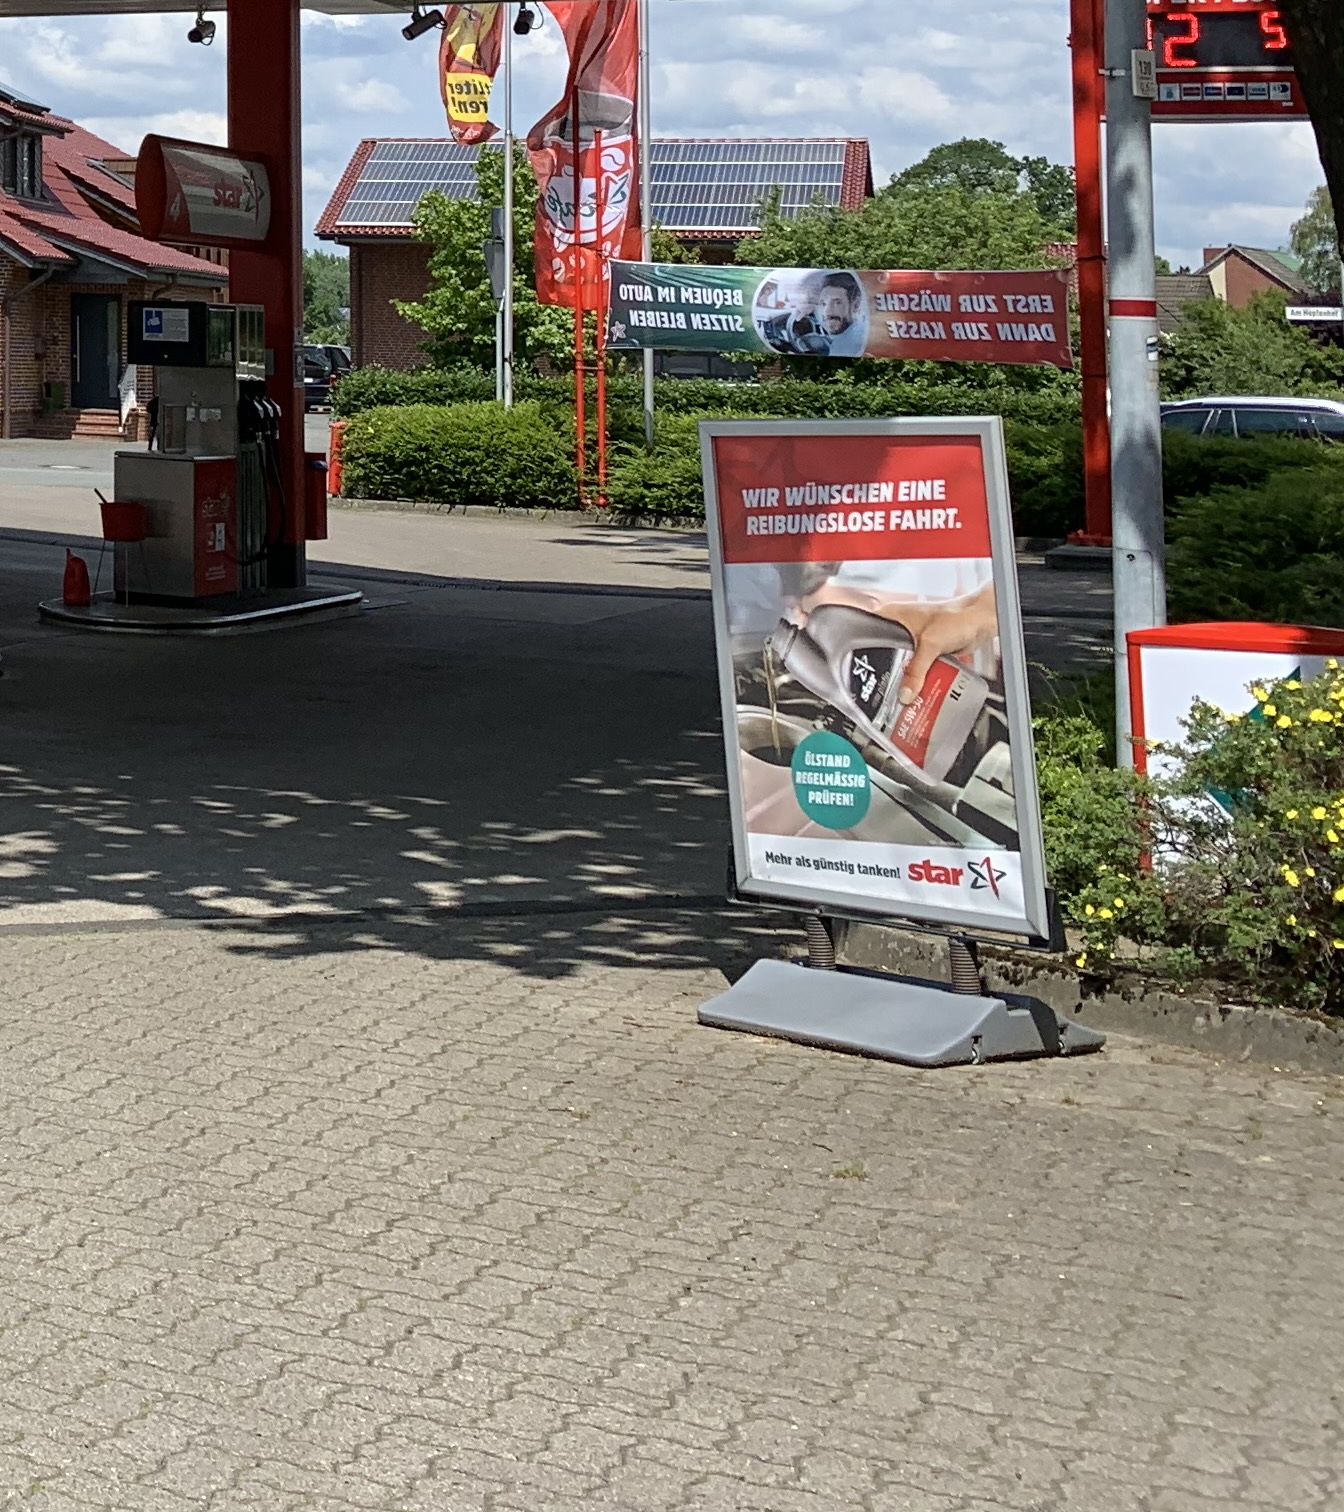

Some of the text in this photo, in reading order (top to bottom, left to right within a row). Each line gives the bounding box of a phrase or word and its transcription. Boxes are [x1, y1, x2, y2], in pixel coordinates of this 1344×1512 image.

[213, 176, 242, 209] star
[169, 192, 181, 223] 4
[742, 479, 946, 508] WIR WÜNSCHEN EINE
[746, 507, 962, 536] REIBUNGSLOSE FAHRT.
[860, 673, 878, 703] star
[949, 689, 962, 702] 1L
[897, 723, 909, 740] SAE
[804, 750, 851, 768] ÖLSTAND
[795, 770, 866, 788] REGELMÄSSIG
[808, 789, 854, 807] PRÜFEN!
[765, 850, 901, 880] Mehr als günstig tanken!
[908, 859, 964, 886] star
